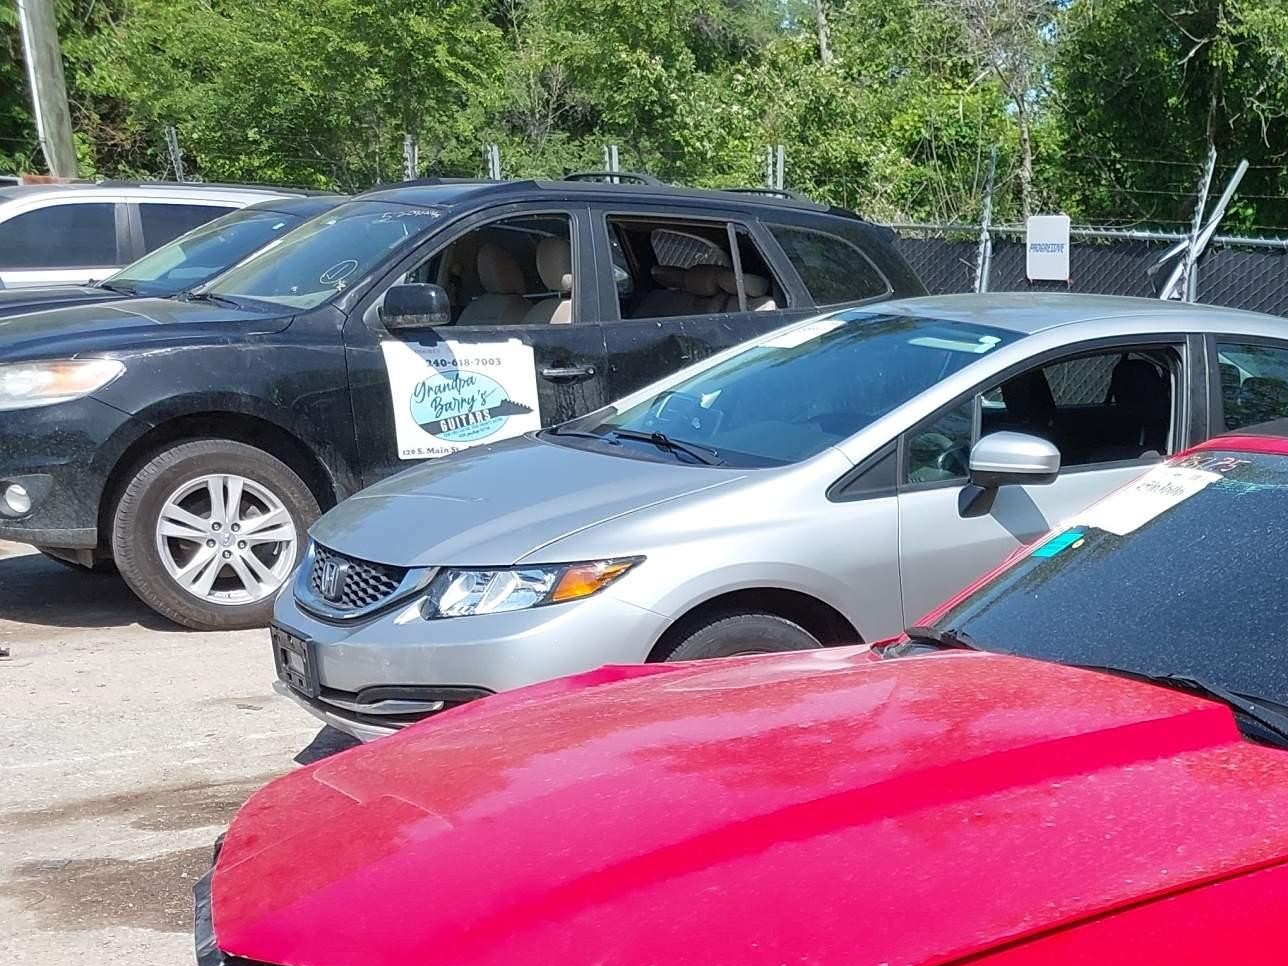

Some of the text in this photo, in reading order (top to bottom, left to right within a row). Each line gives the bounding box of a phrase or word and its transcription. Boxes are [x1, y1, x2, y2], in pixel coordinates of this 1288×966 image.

[1029, 243, 1064, 253] PROGRESSIVE
[426, 358, 502, 367] 240-618-7003
[413, 372, 477, 404] Grandpa
[430, 387, 497, 418] Barry's
[440, 409, 491, 432] GUITARS
[426, 447, 449, 455] Main
